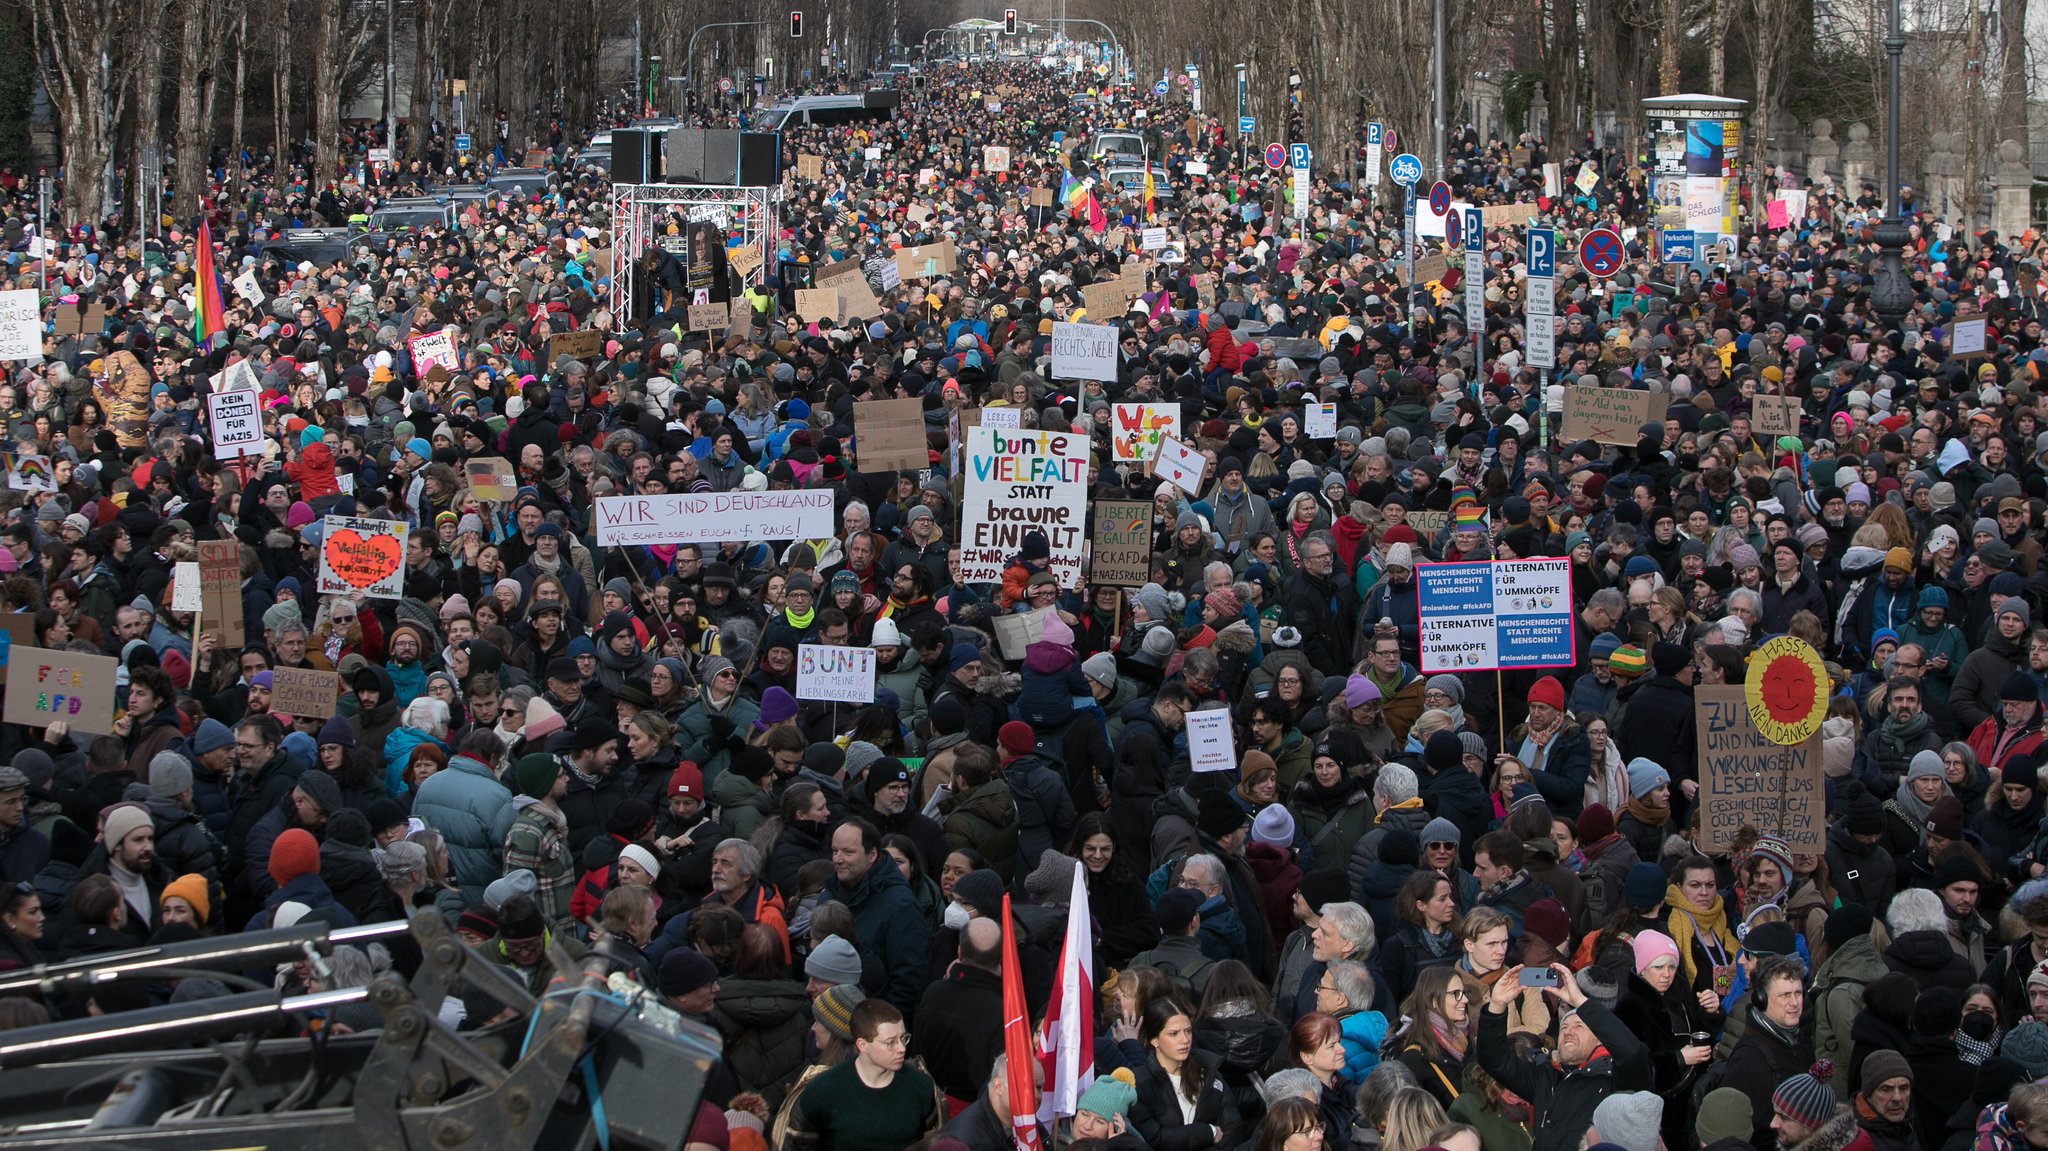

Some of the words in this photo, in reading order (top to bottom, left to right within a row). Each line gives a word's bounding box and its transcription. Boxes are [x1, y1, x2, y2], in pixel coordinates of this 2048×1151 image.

[1370, 125, 1378, 142] P
[1294, 147, 1304, 166] P
[1407, 186, 1412, 212] P
[1688, 202, 1703, 211] DAS
[1688, 206, 1721, 218] SCHLOSS
[1468, 214, 1478, 246] P
[1665, 234, 1693, 242] Parkschein
[731, 250, 760, 269] Presse
[1531, 235, 1546, 270] P
[3, 323, 18, 332] ALS
[1100, 328, 1113, 340] OK
[426, 336, 447, 346] Welt
[221, 395, 244, 405] KEIN
[1616, 390, 1640, 400] dass
[1575, 397, 1588, 406] die
[1614, 404, 1631, 412] was
[1759, 400, 1772, 408] Nie
[217, 406, 252, 419] DÖNER
[987, 412, 1005, 421] LEBE
[1117, 404, 1174, 432] Wir
[1573, 408, 1612, 424] dagegen
[1770, 412, 1782, 421] ist
[226, 420, 246, 430] FÜR
[1761, 422, 1784, 430] heute
[223, 431, 252, 442] NAZIS
[994, 429, 1068, 456] bunte
[973, 454, 1086, 482] VIELFALT
[1008, 485, 1054, 500] STATT
[600, 502, 654, 524] WIR
[664, 498, 708, 516] SIND
[988, 499, 1070, 525] braune
[1095, 504, 1150, 520] LIBERTÉ
[632, 530, 692, 540] SCHMEISSEN
[700, 528, 731, 537] EUCH
[760, 517, 801, 538] RAUS!
[1094, 529, 1148, 546] EGALITÉ
[200, 544, 239, 568] SOLI
[333, 541, 390, 564] Vielfältig
[962, 548, 1003, 564] #WIR
[1094, 551, 1140, 564] FCKAFD
[336, 560, 386, 577] tolerant
[961, 568, 997, 580] #AfD
[1092, 569, 1147, 581] #NAZISRAUS
[1420, 567, 1491, 578] MENSCHENRECHTE
[1495, 565, 1502, 573] A
[1504, 562, 1568, 573] LTERNATIVE
[322, 578, 348, 592] Kinder
[1502, 575, 1516, 584] ÜR
[1504, 585, 1560, 596] UMMKÖPFE
[1422, 622, 1428, 630] A
[1430, 618, 1494, 630] LTERNATIVE
[1498, 618, 1569, 626] MENSCHENRECHTE
[1428, 632, 1442, 641] ÜR
[1430, 642, 1486, 652] UMMKÖPFE
[1762, 636, 1808, 660] HASS?
[801, 648, 874, 674] BUNT
[814, 675, 826, 686] IST
[831, 676, 856, 686] MEINE
[799, 687, 867, 700] LIEBLINGSFARBE
[36, 692, 82, 715] AFD
[1702, 702, 1736, 732] ZU
[1750, 704, 1772, 736] NEIN
[1775, 722, 1812, 742] DANKE
[1707, 733, 1740, 751] UND
[1706, 749, 1808, 777] WIRKUNGEN
[1712, 777, 1764, 794] LESEN
[1766, 776, 1788, 792] SIE
[1790, 778, 1813, 792] DAS
[1708, 796, 1808, 814] GESCHICHTSBUCH
[1712, 812, 1744, 826] ODER
[1752, 812, 1812, 828] FRAGEN
